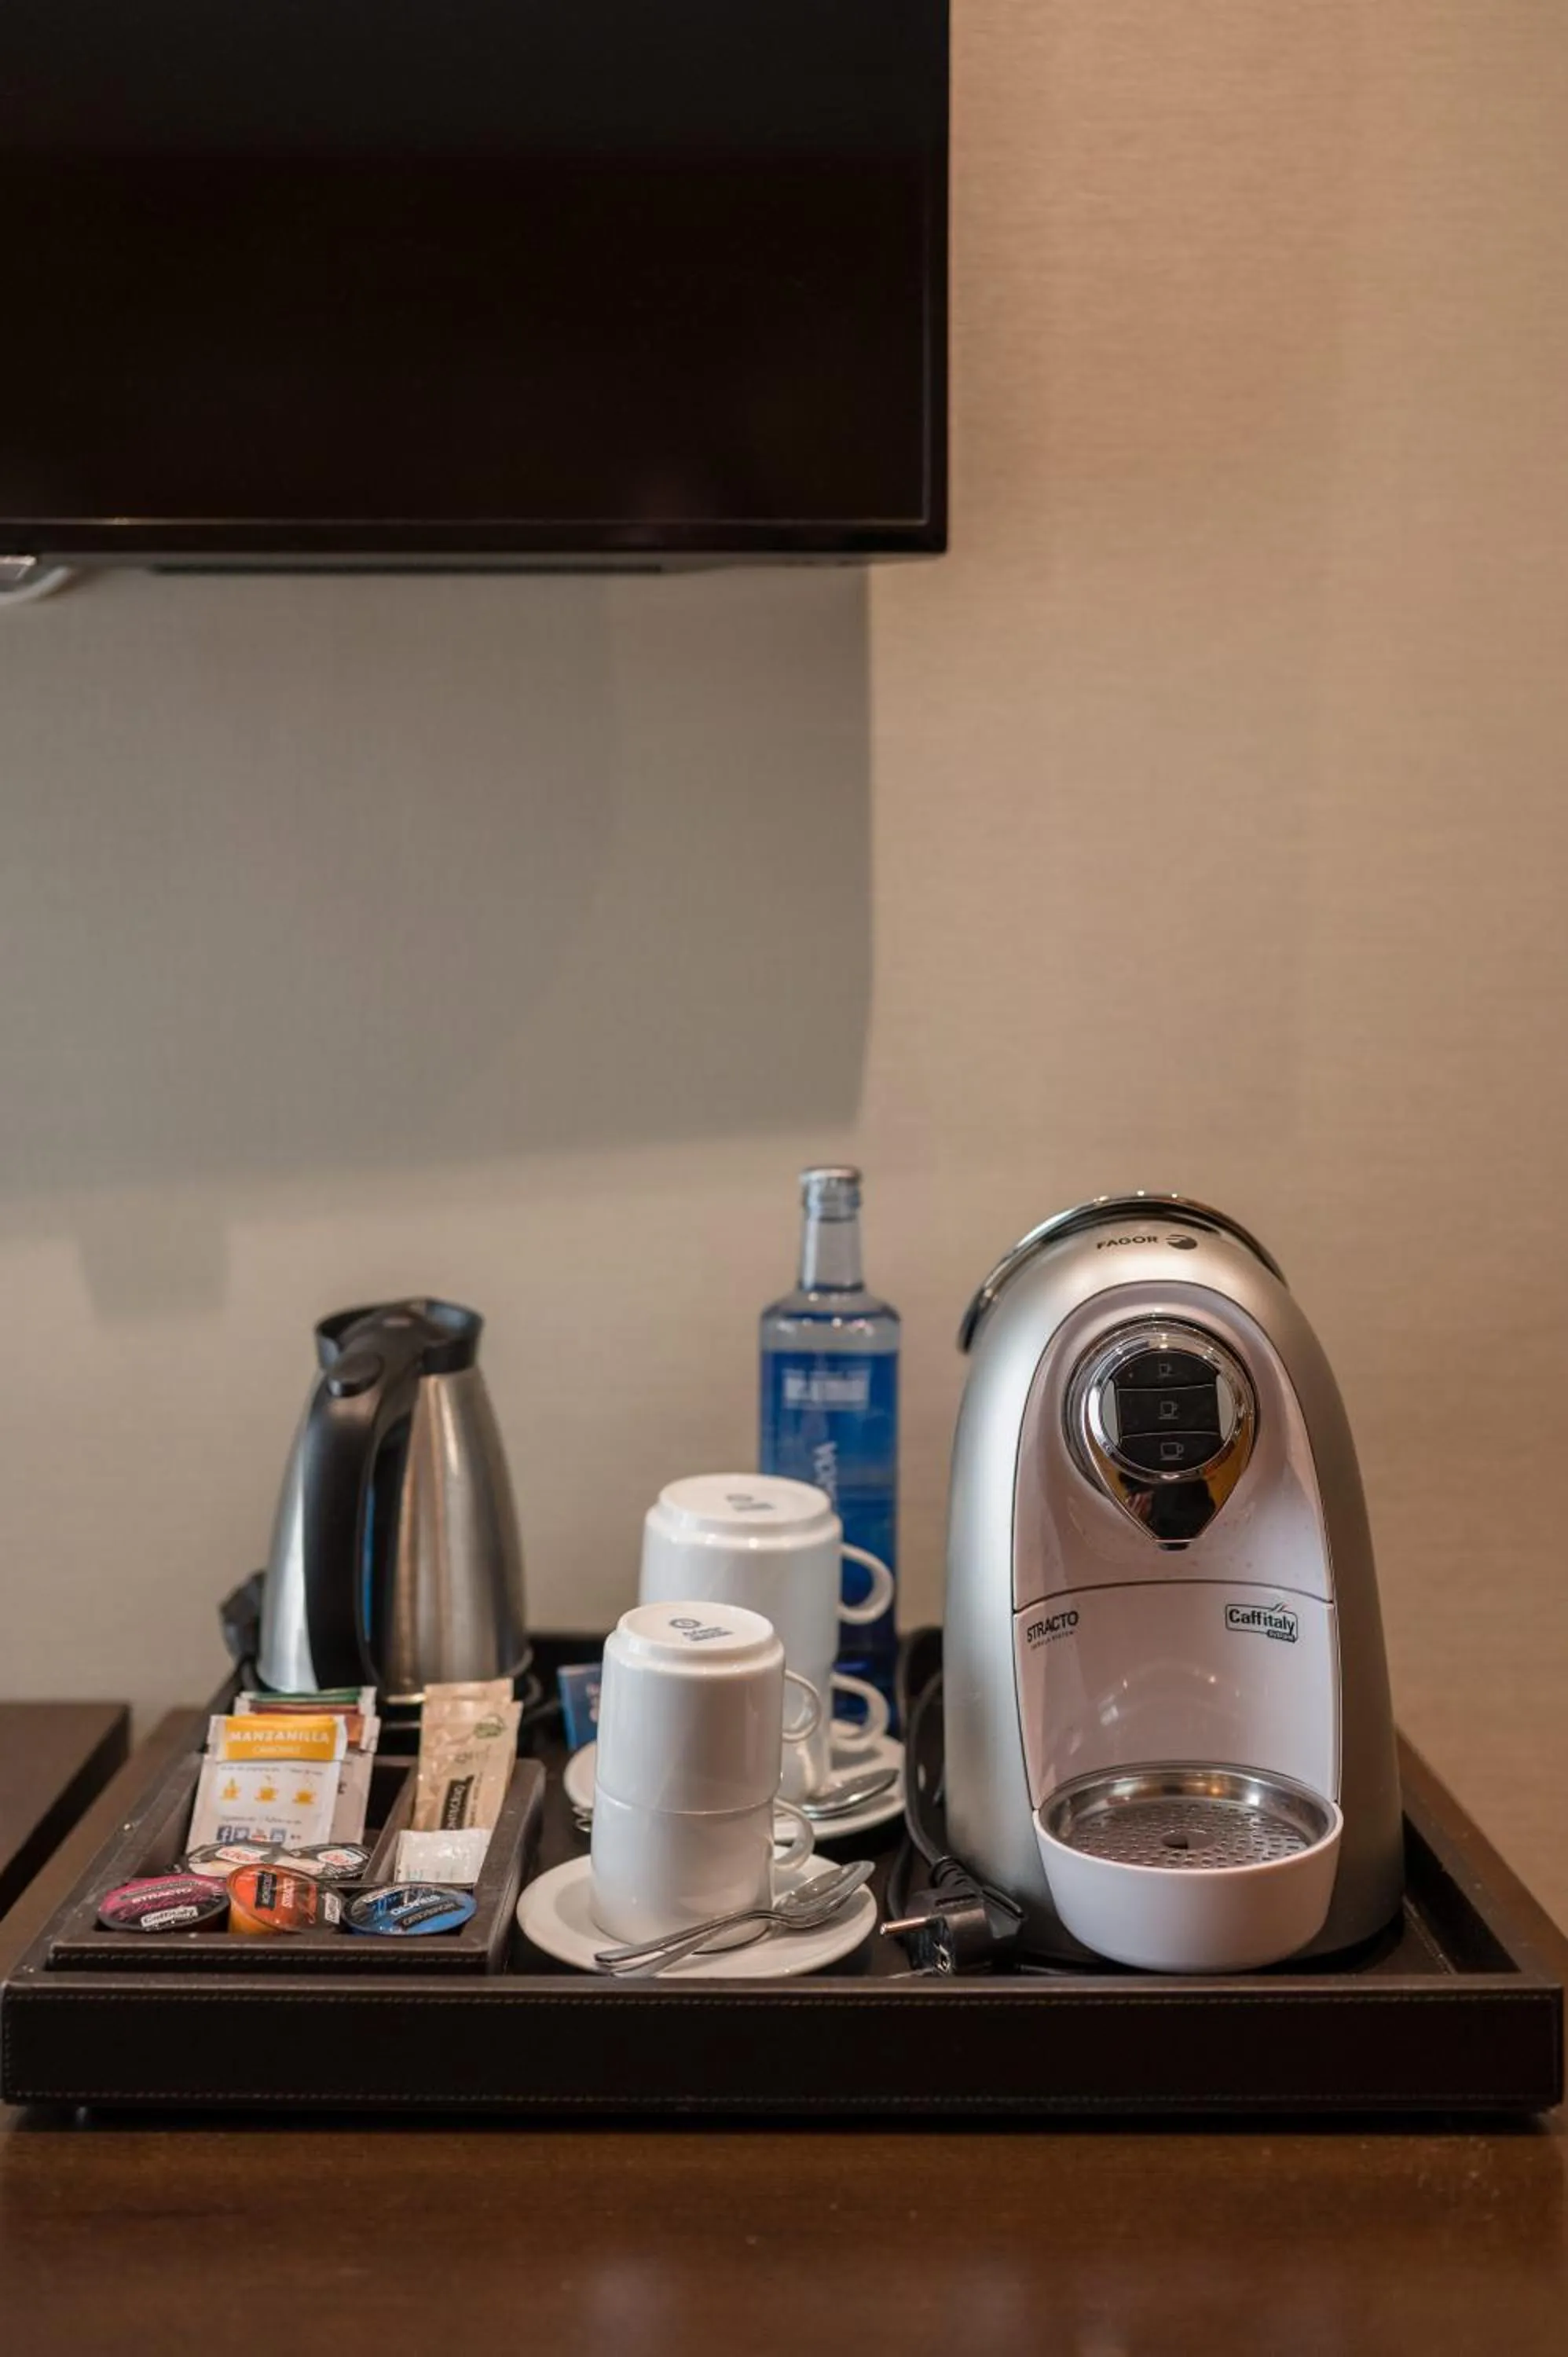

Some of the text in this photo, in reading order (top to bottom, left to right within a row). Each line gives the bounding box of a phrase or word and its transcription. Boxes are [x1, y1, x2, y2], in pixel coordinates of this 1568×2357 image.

[1097, 1236, 1159, 1249] FAGOR
[1027, 1611, 1079, 1643] STRACTO
[1229, 1608, 1295, 1635] Caffitaly
[229, 1729, 330, 1743] MANZANILLA
